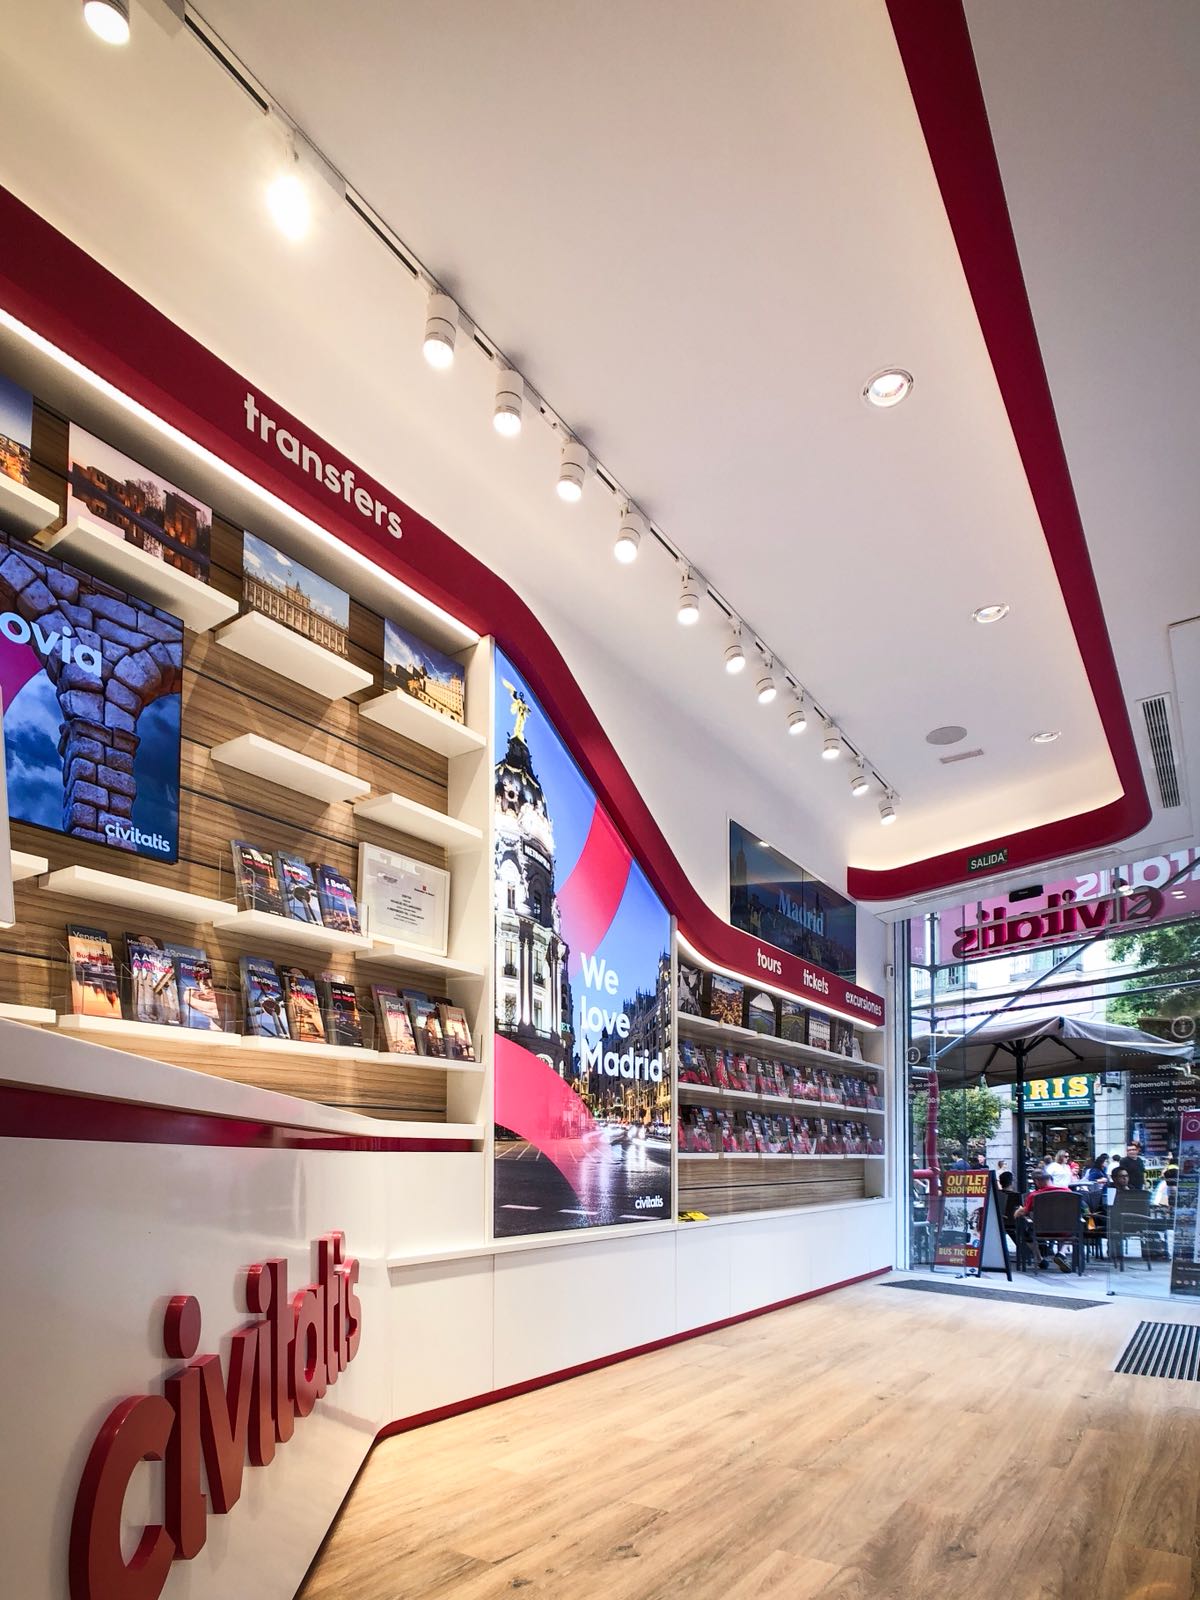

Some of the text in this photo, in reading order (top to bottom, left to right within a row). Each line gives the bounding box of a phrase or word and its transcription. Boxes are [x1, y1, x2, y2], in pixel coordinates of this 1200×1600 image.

[244, 392, 403, 539] transfers
[0, 611, 103, 678] ovia
[104, 822, 171, 852] civitatis
[970, 852, 1005, 870] SALIDA
[778, 888, 824, 937] Madrid
[72, 930, 107, 944] Venecia
[180, 962, 210, 974] Florencia
[580, 952, 619, 995] We
[757, 948, 782, 975] tours
[803, 968, 829, 995] tickets
[581, 995, 631, 1038] love
[845, 991, 882, 1016] excursiones
[581, 1038, 663, 1083] Madrid
[1016, 1077, 1089, 1100] RIS
[946, 1186, 987, 1194] SHOPPING
[947, 1174, 988, 1186] OUTLET
[634, 1195, 664, 1209] civitatis
[938, 1247, 952, 1256] BUS
[69, 1230, 361, 1600] civitatis
